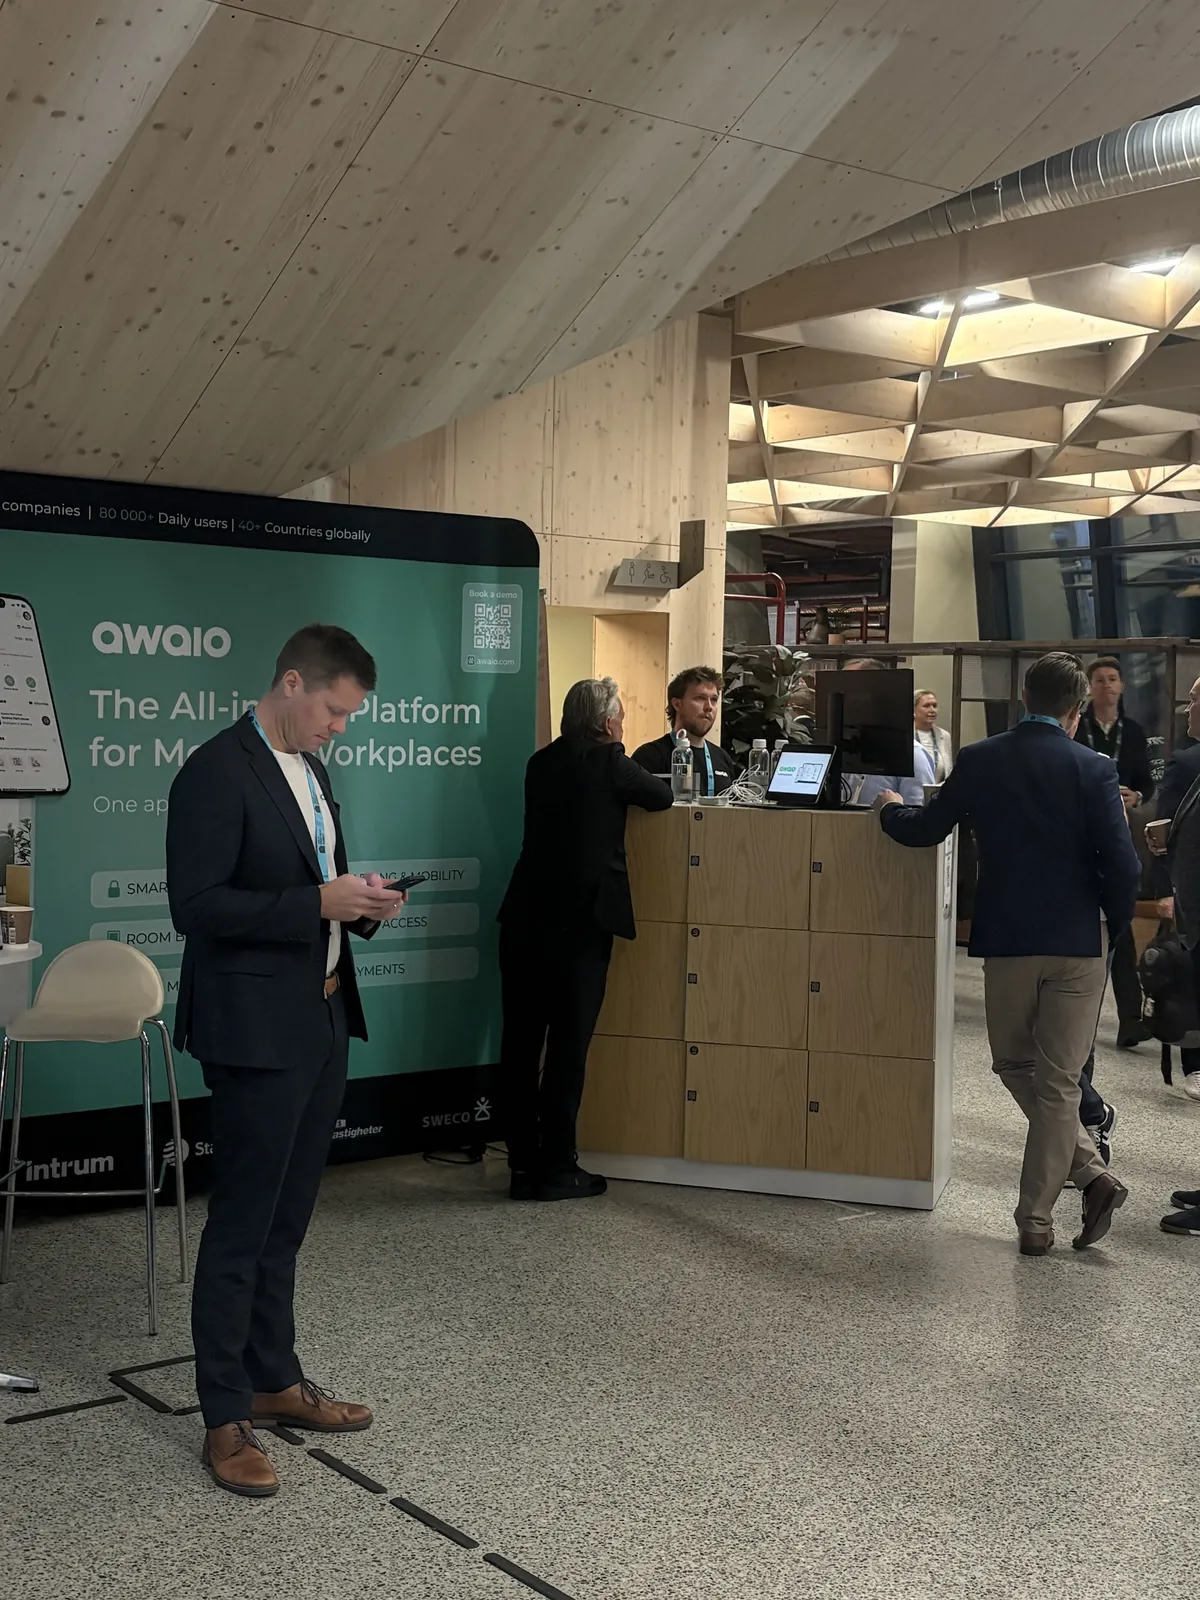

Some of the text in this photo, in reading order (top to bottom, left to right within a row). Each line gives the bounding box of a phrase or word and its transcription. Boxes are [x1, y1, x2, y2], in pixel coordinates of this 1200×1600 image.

[2, 501, 81, 517] companies
[99, 506, 117, 519] 80
[120, 508, 155, 522] 000+
[158, 512, 191, 528] Daily
[194, 517, 228, 529] users
[238, 520, 261, 531] 40+
[264, 522, 323, 537] Countries
[325, 527, 372, 543] globally
[469, 589, 488, 598] Book
[496, 591, 518, 599] demo
[89, 689, 160, 720] The
[350, 694, 481, 724] Platform
[89, 736, 141, 767] for
[93, 795, 138, 813] One
[382, 916, 428, 929] ACCESS
[126, 931, 171, 945] ROOM
[356, 963, 406, 977] YMENTS
[422, 1111, 470, 1128] SWECO
[332, 1125, 383, 1139] astigheter
[26, 1155, 114, 1182] intrum
